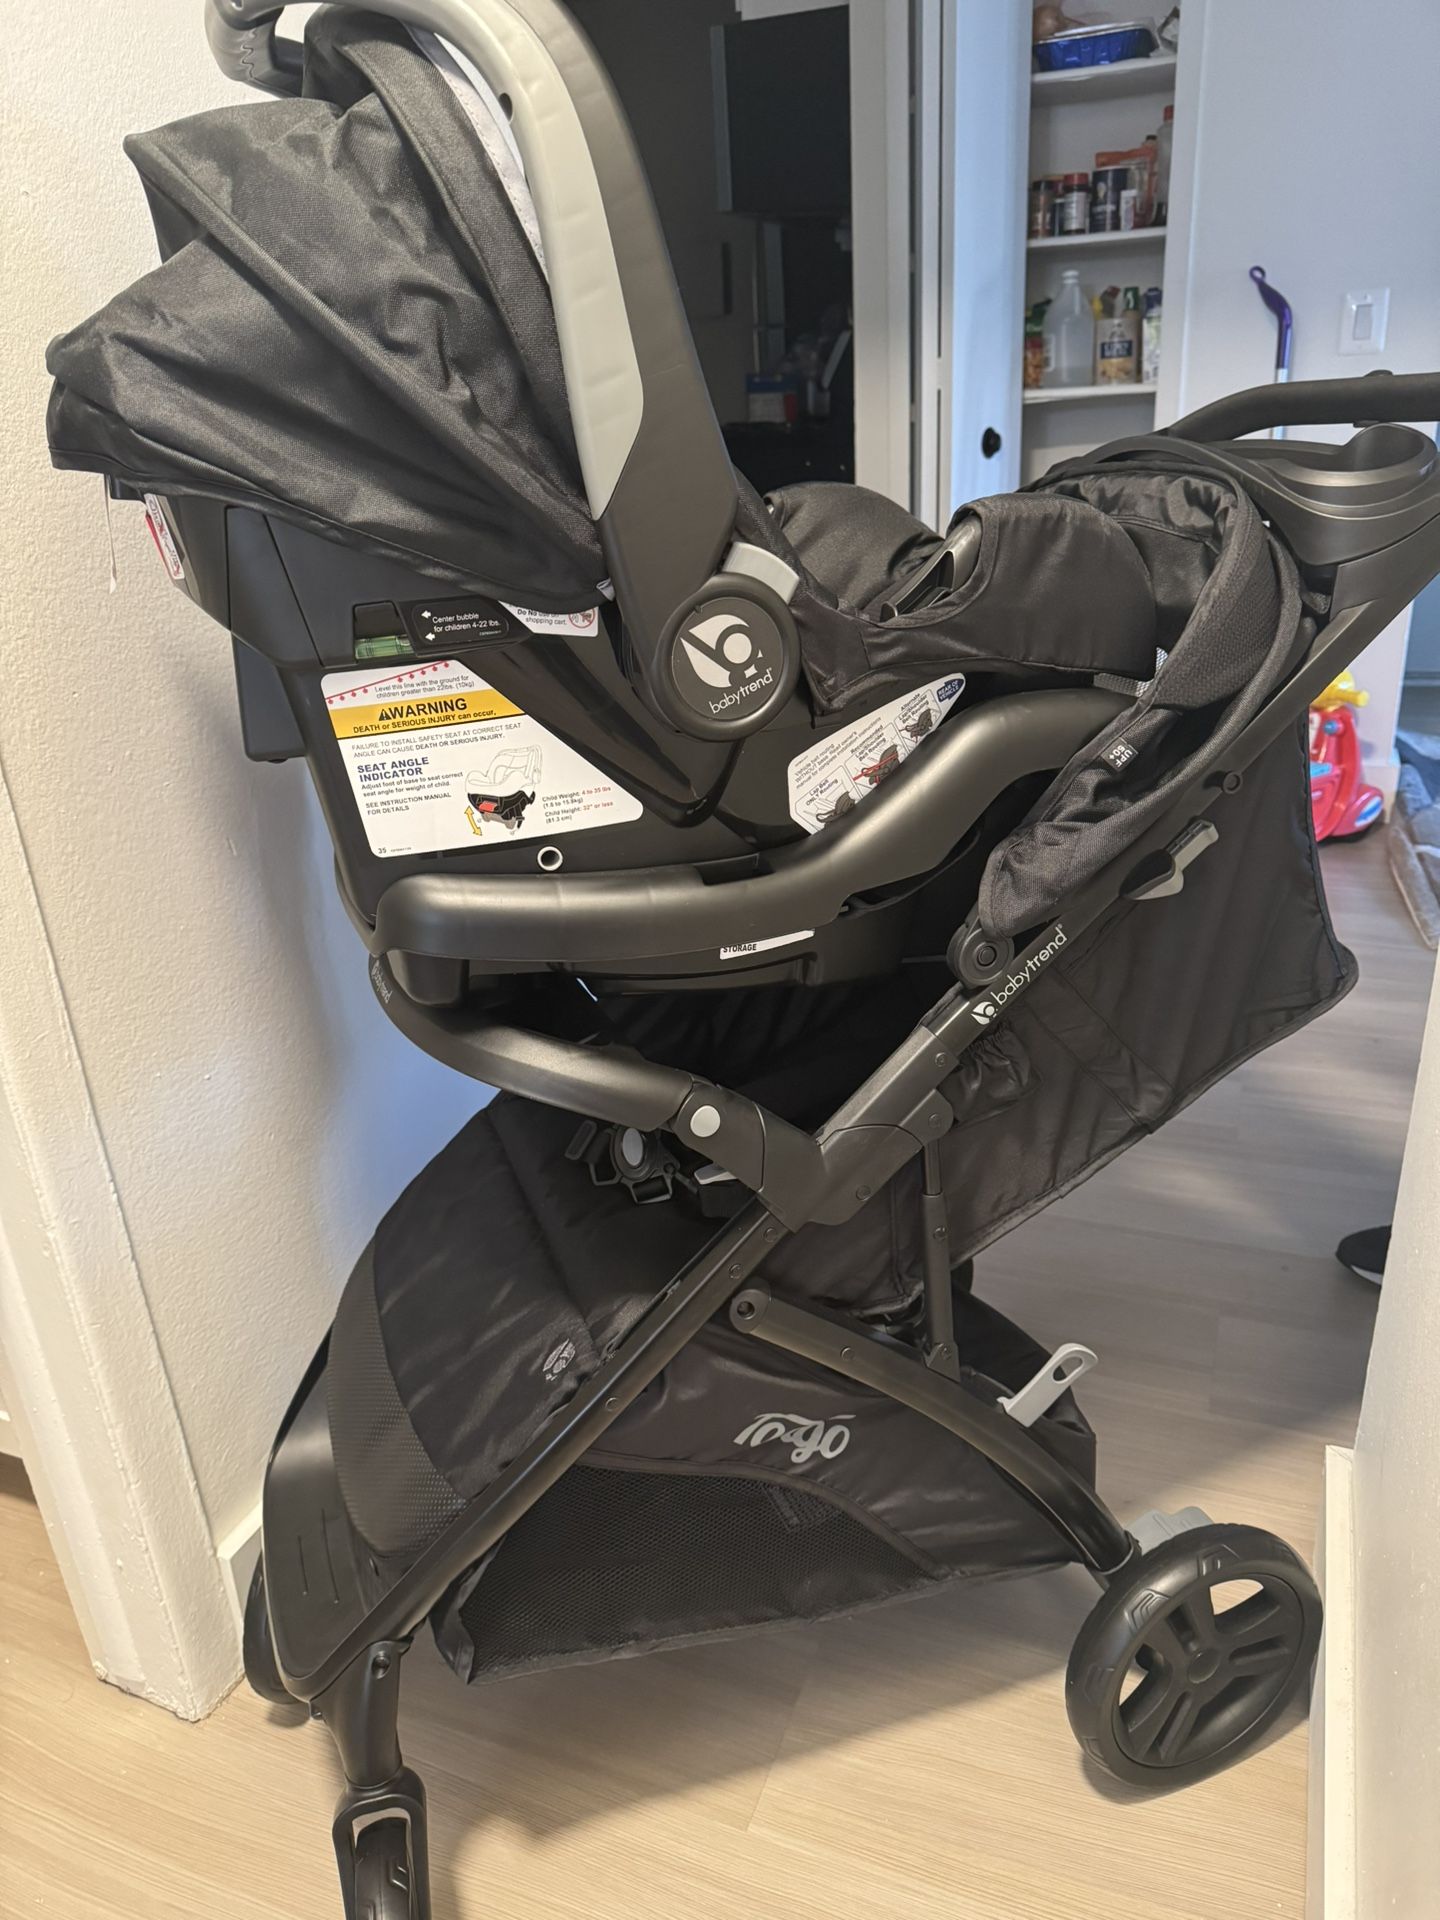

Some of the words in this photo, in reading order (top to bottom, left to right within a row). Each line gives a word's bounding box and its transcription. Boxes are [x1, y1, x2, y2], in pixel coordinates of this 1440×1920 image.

[432, 616, 455, 624] Center
[445, 623, 471, 632] children
[472, 620, 488, 628] 4-22
[526, 616, 553, 626] shopping
[430, 678, 438, 686] the
[440, 676, 460, 686] ground
[376, 690, 400, 699] children
[401, 688, 421, 698] greater
[422, 686, 436, 694] than
[437, 684, 455, 692] 22lbs.
[456, 681, 475, 690] (10kg)
[708, 669, 774, 714] babytrend
[388, 698, 468, 720] WARNING
[354, 724, 380, 734] DEATH
[392, 718, 427, 729] SERIOUS
[428, 714, 456, 724] INJURY
[352, 741, 379, 750] FAILURE
[391, 737, 417, 746] INSTALL
[418, 734, 443, 743] SAFETY
[444, 731, 461, 739] SEAT
[472, 726, 503, 735] CORRECT
[505, 722, 521, 730] SEAT
[353, 750, 375, 758] ANGLE
[377, 748, 391, 756] CAN
[392, 745, 415, 754] CAUSE
[416, 742, 438, 751] DEATH
[450, 736, 478, 746] SERIOUS
[480, 733, 505, 742] INJURY.
[358, 762, 387, 773] SEAT
[391, 756, 430, 769] ANGLE
[1115, 750, 1132, 768] UPF
[360, 767, 423, 782] INDICATOR
[795, 762, 817, 782] WITHOUT
[362, 782, 382, 790] Adjust
[378, 788, 394, 796] angle
[405, 784, 426, 792] weight
[806, 793, 819, 805] ONLY
[819, 779, 838, 795] Routing
[810, 787, 819, 796] Lap
[819, 779, 829, 788] Belt
[380, 797, 423, 807] INSTRUCTION
[424, 792, 452, 801] MANUAL
[542, 794, 558, 802] Child
[382, 805, 410, 814] DETAILS
[723, 944, 757, 952] STORAGE
[990, 925, 1067, 1005] babytrend
